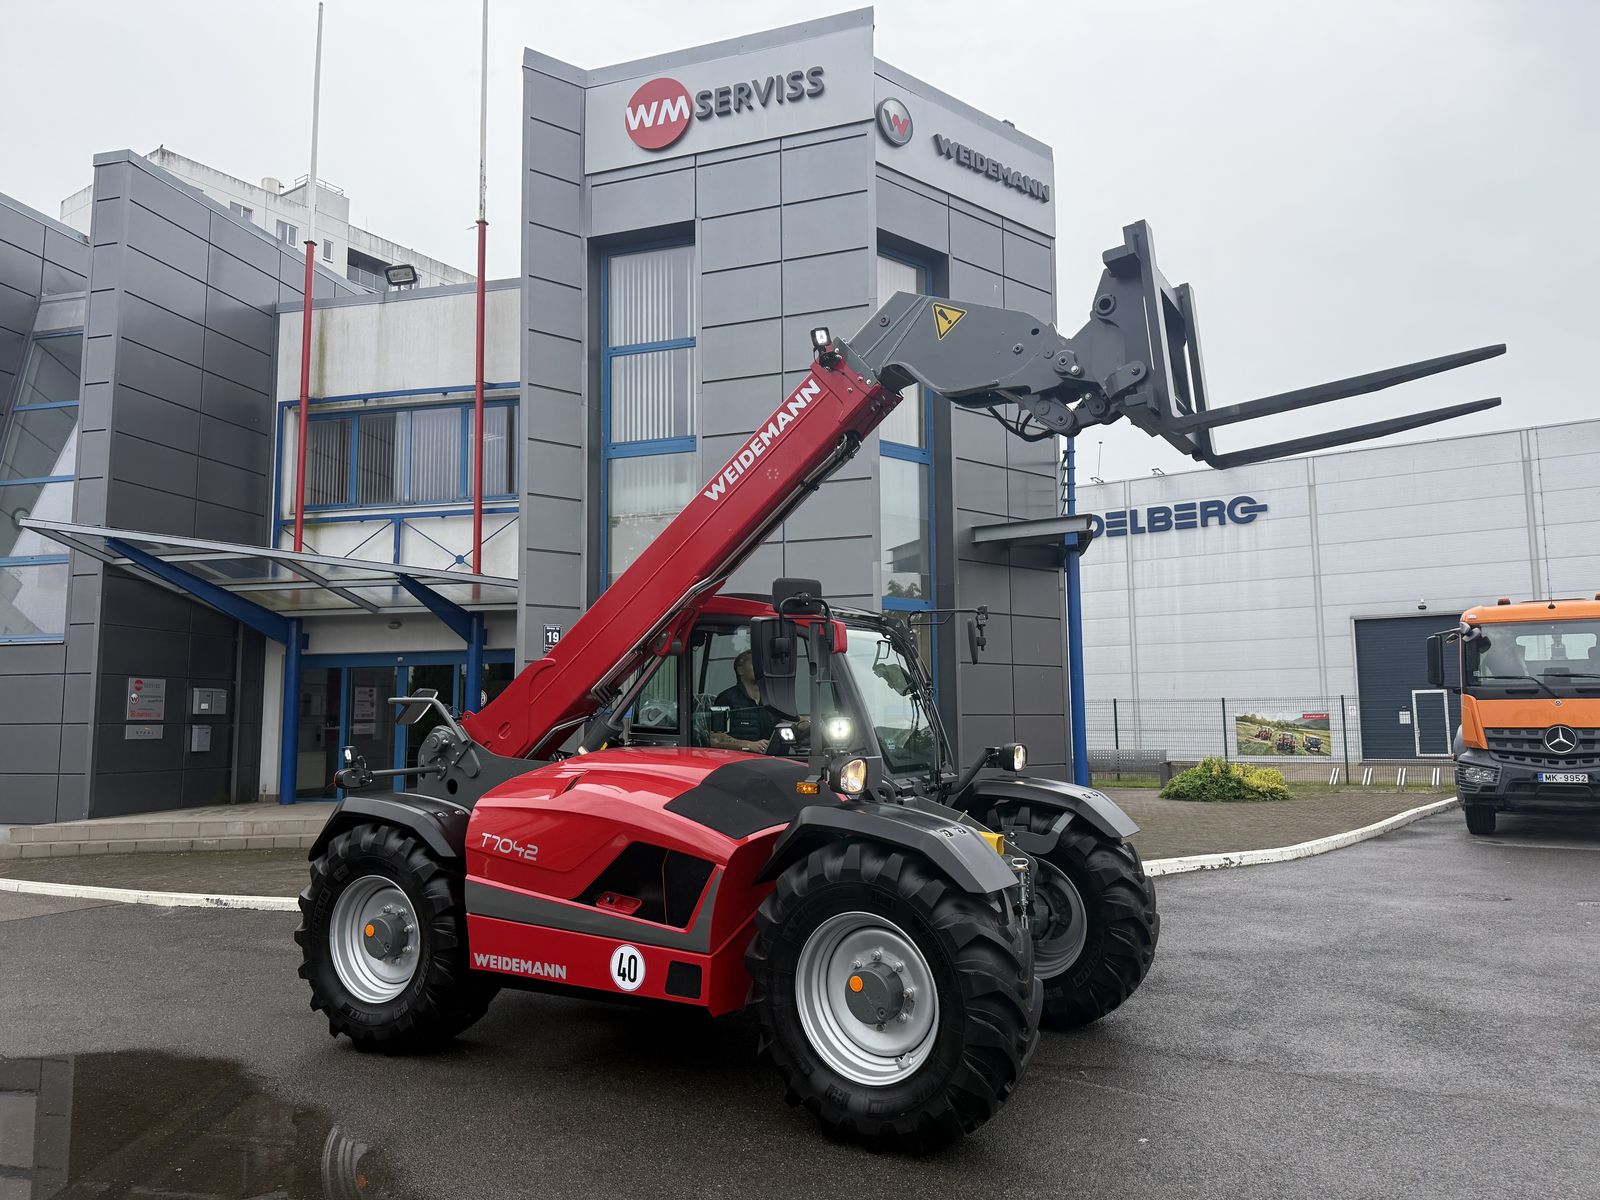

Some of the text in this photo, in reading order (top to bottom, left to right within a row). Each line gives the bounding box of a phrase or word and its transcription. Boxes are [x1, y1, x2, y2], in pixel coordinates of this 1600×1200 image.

[625, 66, 824, 131] WM SERVISS
[933, 133, 1050, 202] WEIDEMANN
[703, 378, 821, 501] WEIDEMANN
[546, 631, 559, 643] 19
[480, 832, 539, 861] T7042
[473, 952, 568, 981] WEIDEMANN
[616, 952, 638, 983] 40
